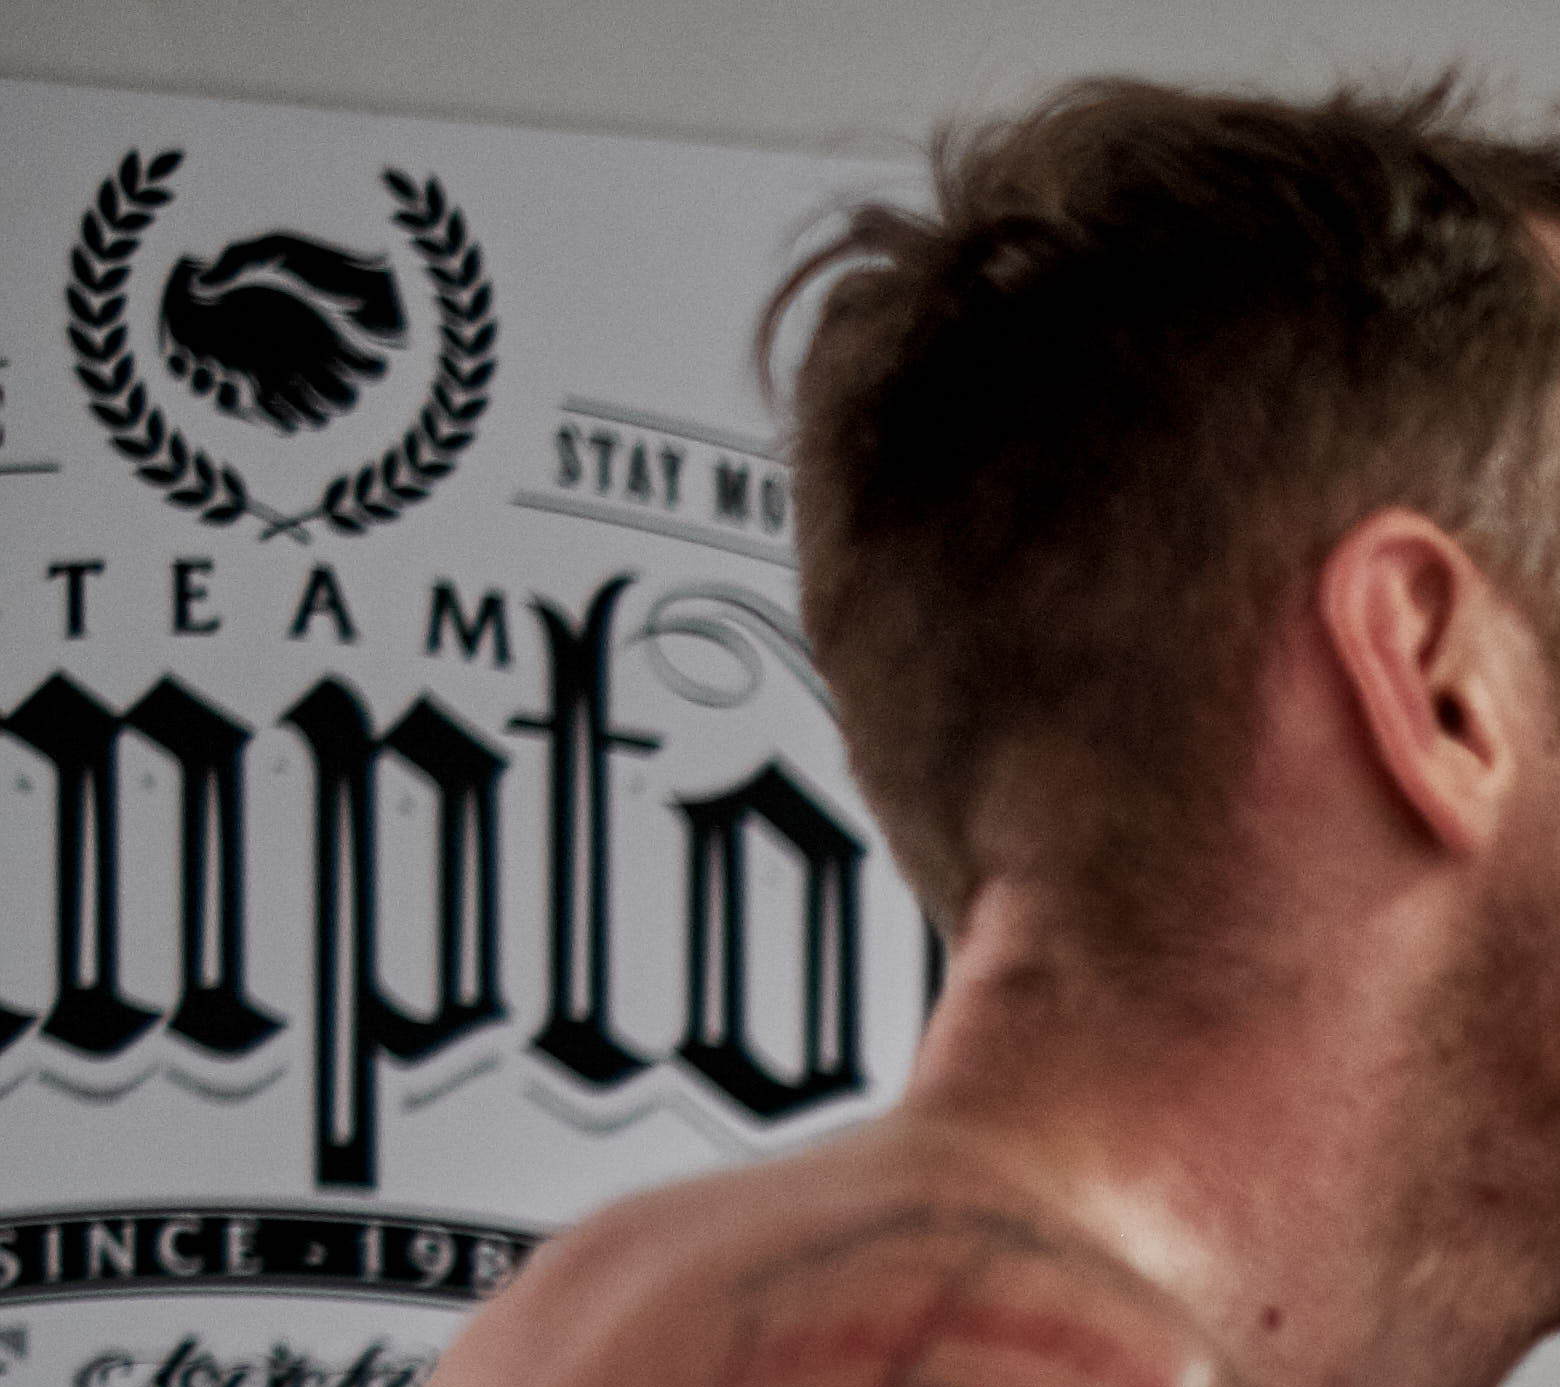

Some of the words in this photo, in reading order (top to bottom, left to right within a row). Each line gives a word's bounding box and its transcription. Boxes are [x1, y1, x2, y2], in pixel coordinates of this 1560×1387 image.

[555, 423, 688, 512] STAY
[48, 559, 515, 668] TEAM
[0, 574, 947, 1190] mpto
